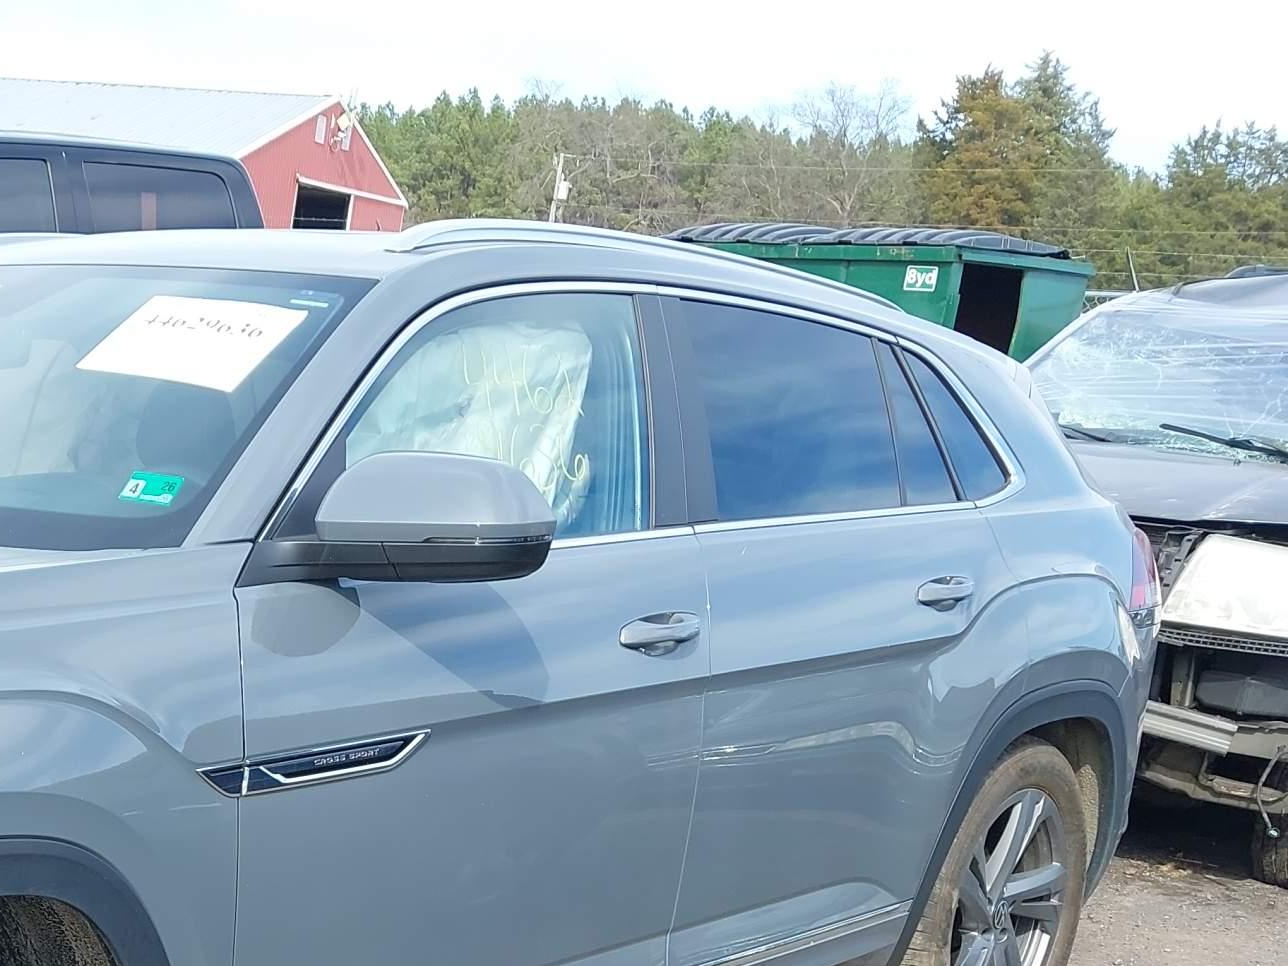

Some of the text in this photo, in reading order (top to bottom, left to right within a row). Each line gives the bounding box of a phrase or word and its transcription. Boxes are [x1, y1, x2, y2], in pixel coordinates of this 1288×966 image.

[907, 268, 937, 288] 8yd
[129, 481, 177, 494] 4 26
[314, 748, 380, 766] CROSS SPORT
